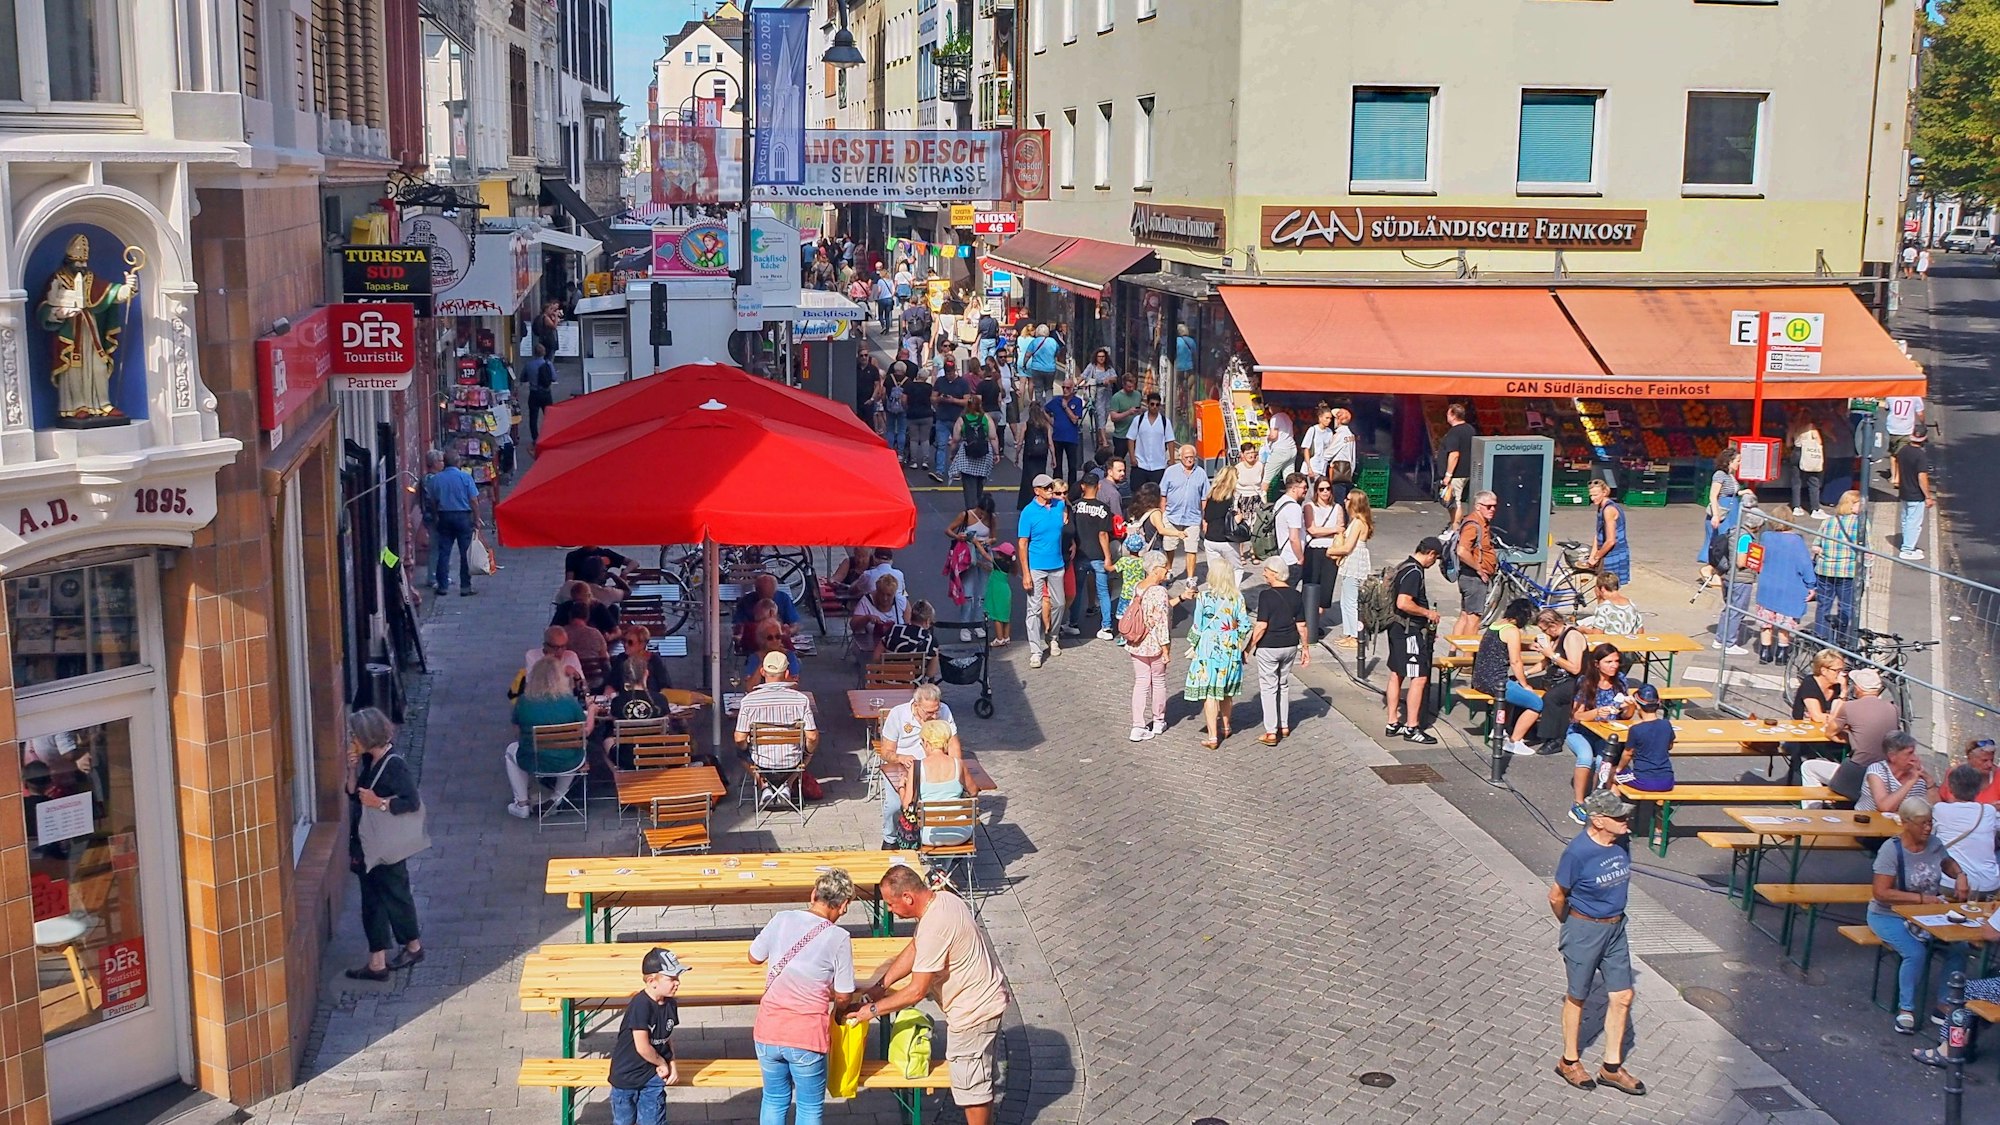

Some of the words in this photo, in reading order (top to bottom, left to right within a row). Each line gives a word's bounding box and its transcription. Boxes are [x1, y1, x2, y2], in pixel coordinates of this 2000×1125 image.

[760, 12, 772, 67] 10.9.2023
[757, 117, 771, 181] SEVERINALE
[904, 138, 986, 164] DESCH
[831, 165, 987, 184] SEVERINSTRASSE
[770, 186, 783, 196] 3.
[788, 185, 878, 197] Wochenende
[884, 185, 900, 196] im
[905, 184, 981, 198] September
[975, 213, 1015, 224] KIOSK
[1270, 207, 1364, 247] CAN
[1371, 215, 1529, 239] SÜDLÄNDISCHE
[988, 223, 1004, 233] 46
[345, 249, 427, 262] TURISTA
[364, 281, 410, 292] Tapas-Bar
[802, 310, 858, 318] Backfisch
[342, 321, 404, 348] DER
[1737, 320, 1752, 343] E
[1793, 322, 1805, 337] H
[344, 351, 404, 363] Touristik
[347, 377, 398, 388] Partner
[1506, 381, 1538, 393] CAN
[1543, 382, 1643, 395] Südländische
[1648, 384, 1711, 395] Feinkost
[1894, 399, 1912, 417] 07
[1494, 443, 1544, 452] Chlodwigplatz
[19, 498, 79, 536] A.D.
[134, 487, 194, 516] 1895.
[1076, 501, 1108, 519] Angels
[104, 950, 141, 976] DER
[106, 968, 141, 985] Touristik
[108, 1000, 138, 1017] Partner
